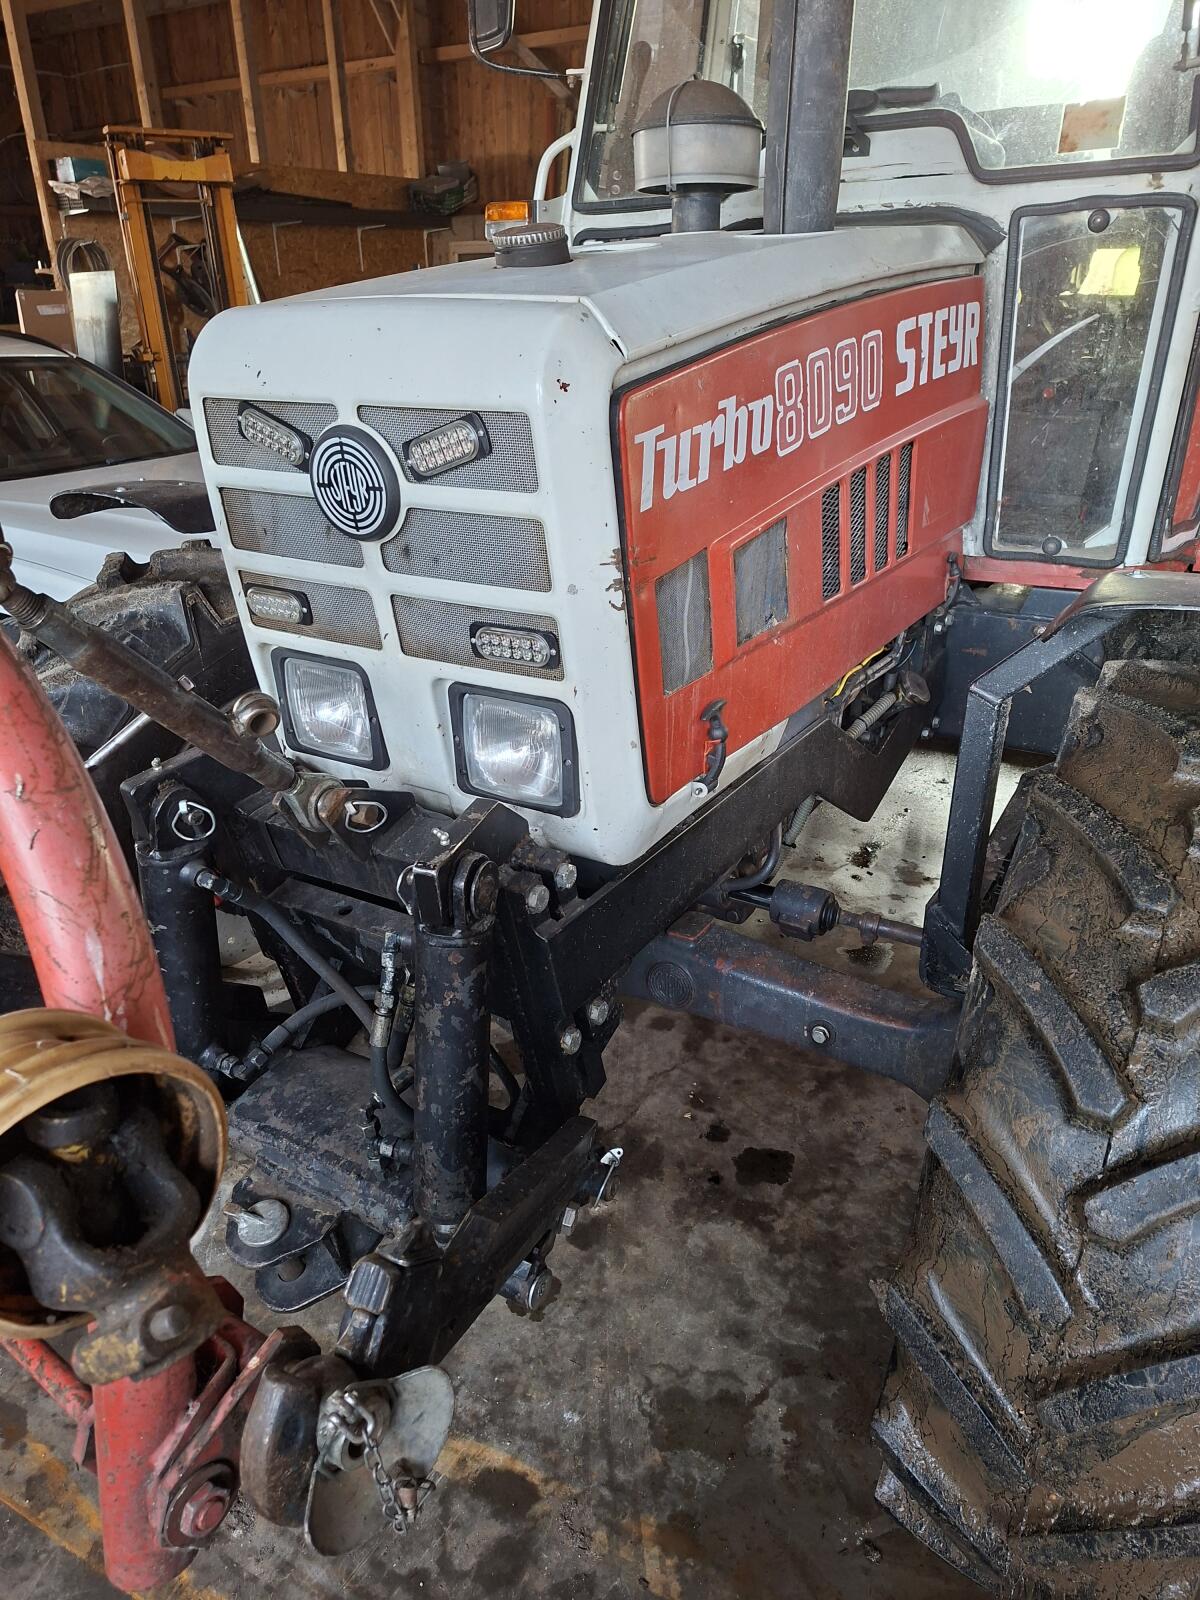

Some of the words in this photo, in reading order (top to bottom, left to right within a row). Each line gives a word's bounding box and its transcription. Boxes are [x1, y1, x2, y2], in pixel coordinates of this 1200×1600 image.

[634, 395, 774, 512] Turbo
[775, 329, 883, 457] 8090
[895, 301, 981, 396] STEYR
[330, 461, 369, 513] STEYR
